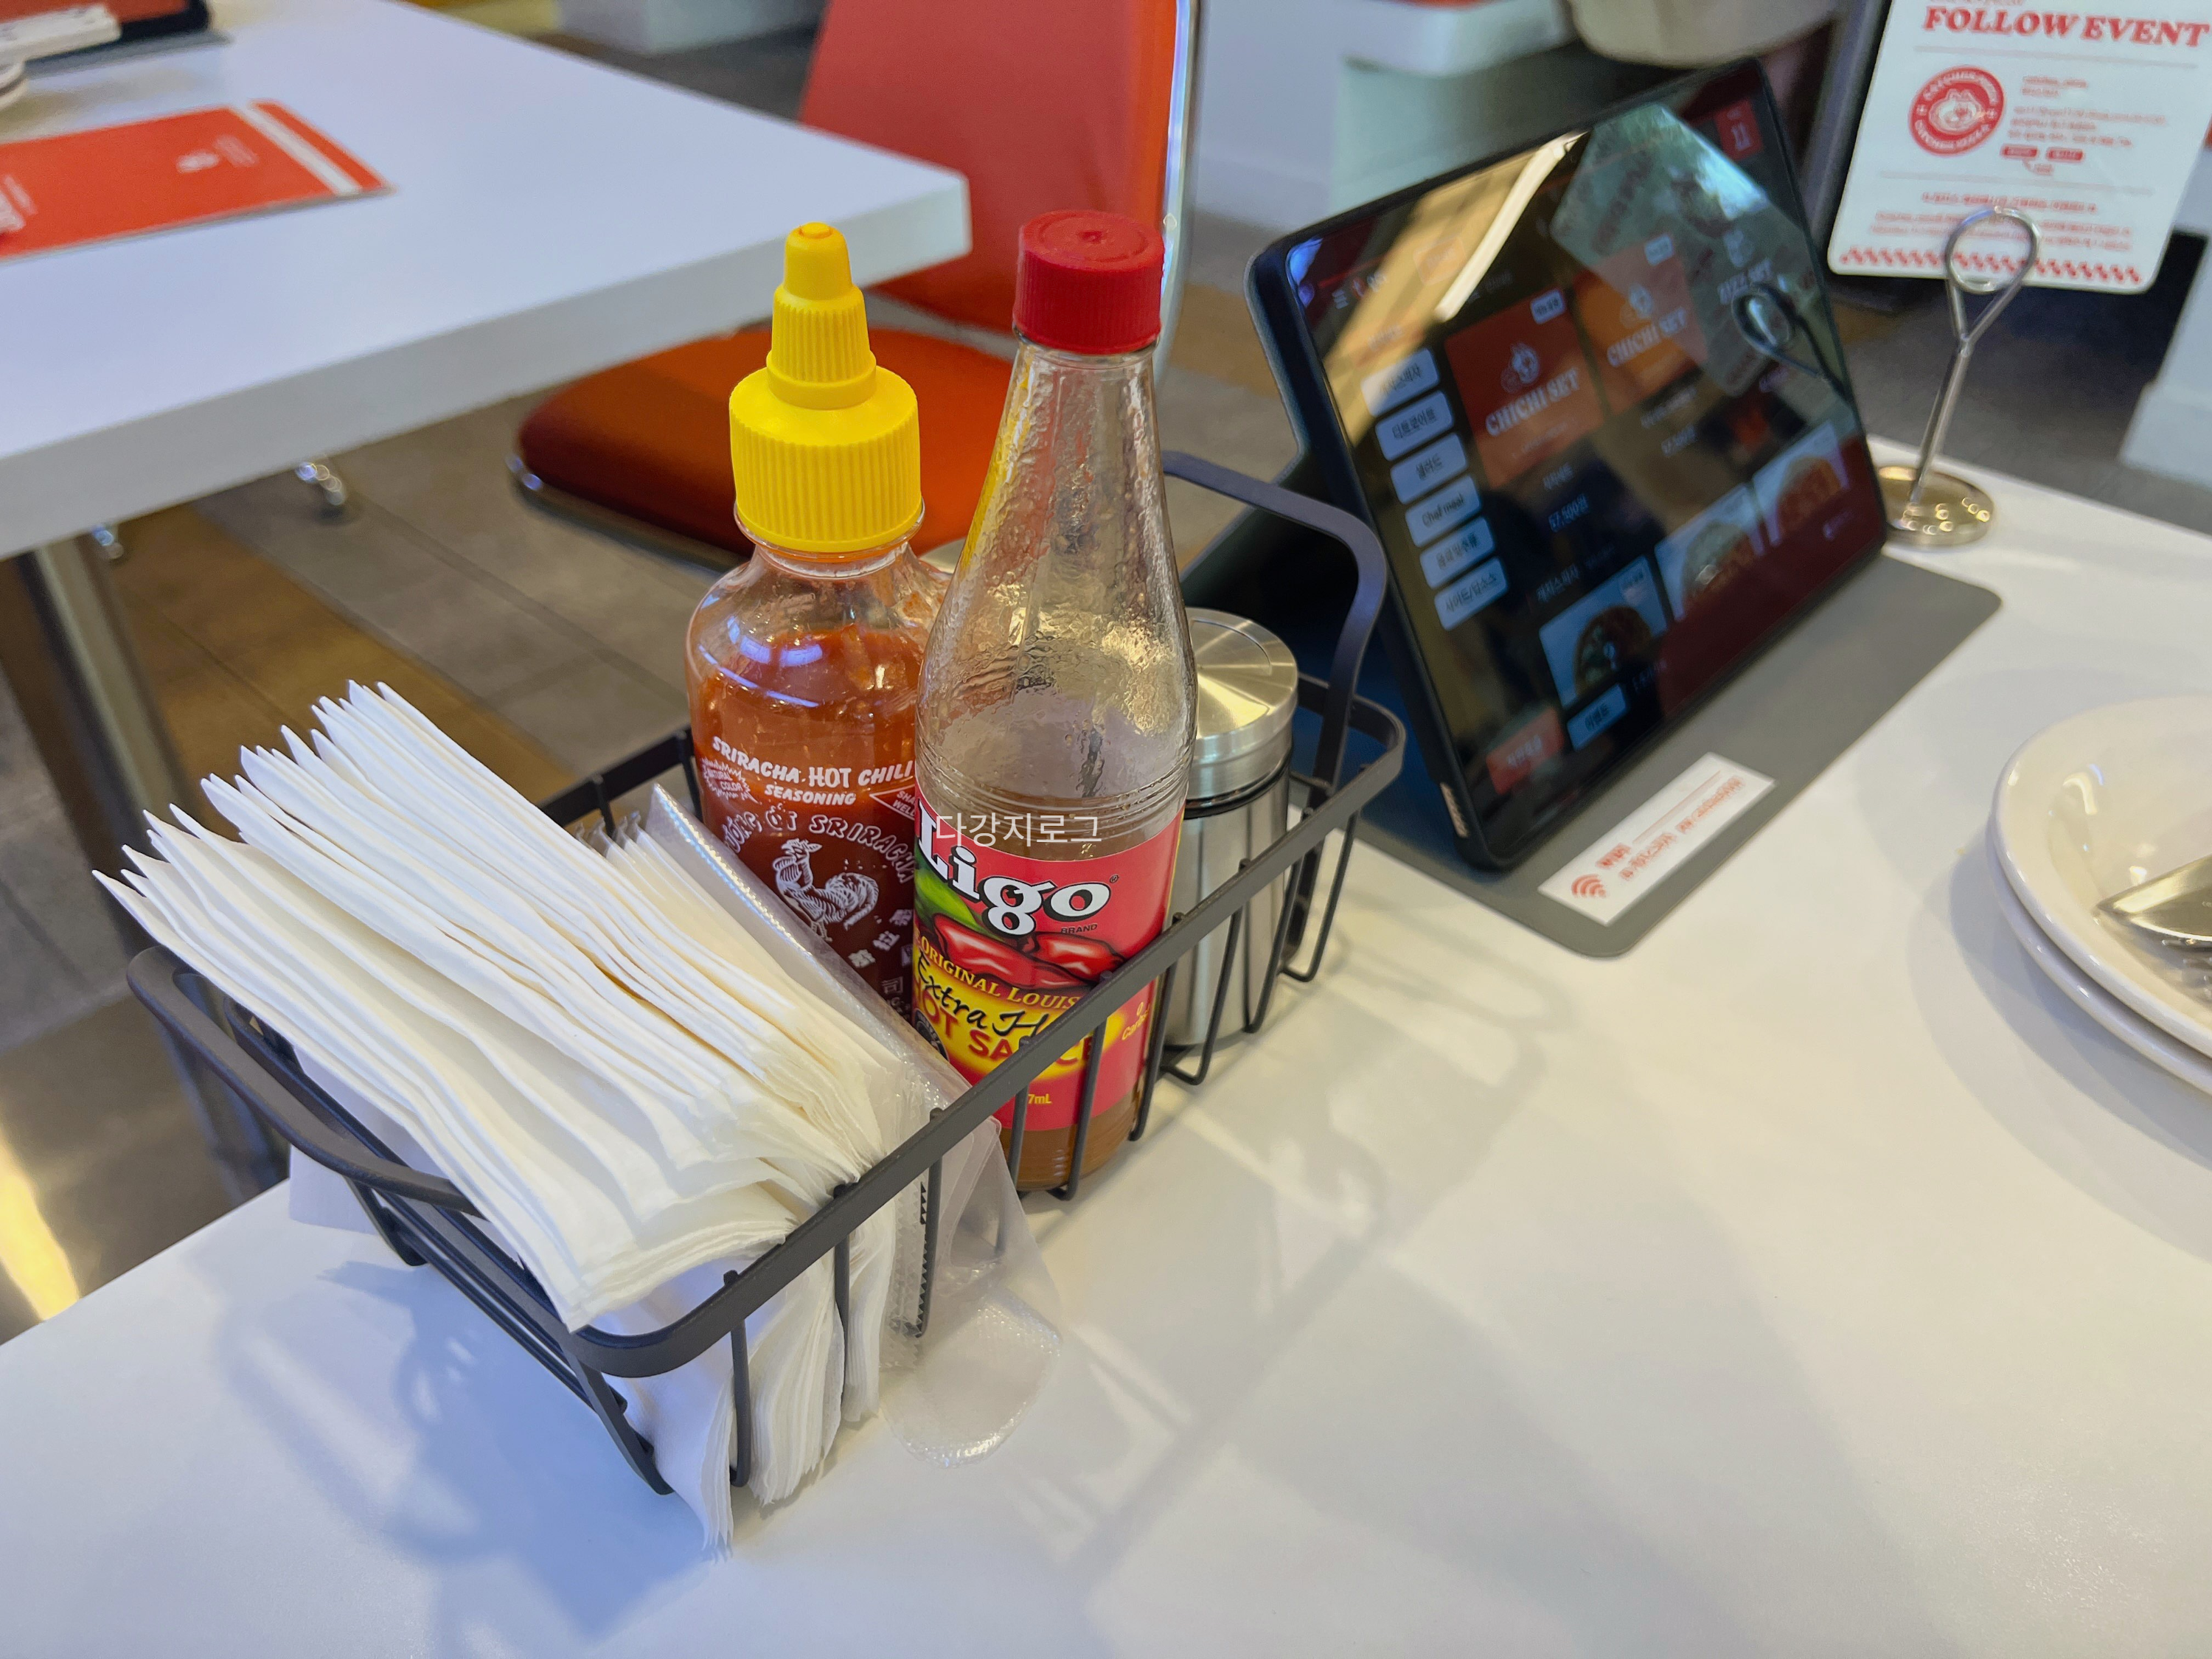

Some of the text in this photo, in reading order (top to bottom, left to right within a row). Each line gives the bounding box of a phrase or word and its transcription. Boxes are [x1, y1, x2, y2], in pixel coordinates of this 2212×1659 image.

[1923, 5, 2211, 47] FOLLOW EVENT
[1484, 366, 1579, 437] CHICHI SET
[712, 735, 914, 788] SRIRACHA HOT CHILI
[720, 782, 743, 792] COLOR
[765, 783, 857, 806] SEASONING
[917, 799, 1112, 937] Ligo
[1060, 923, 1099, 935] BRAND
[917, 950, 990, 1029] Extra
[921, 934, 1001, 998] ORIGINAL
[1006, 985, 1084, 1011] LOUIS
[1028, 1093, 1053, 1105] 7mL
